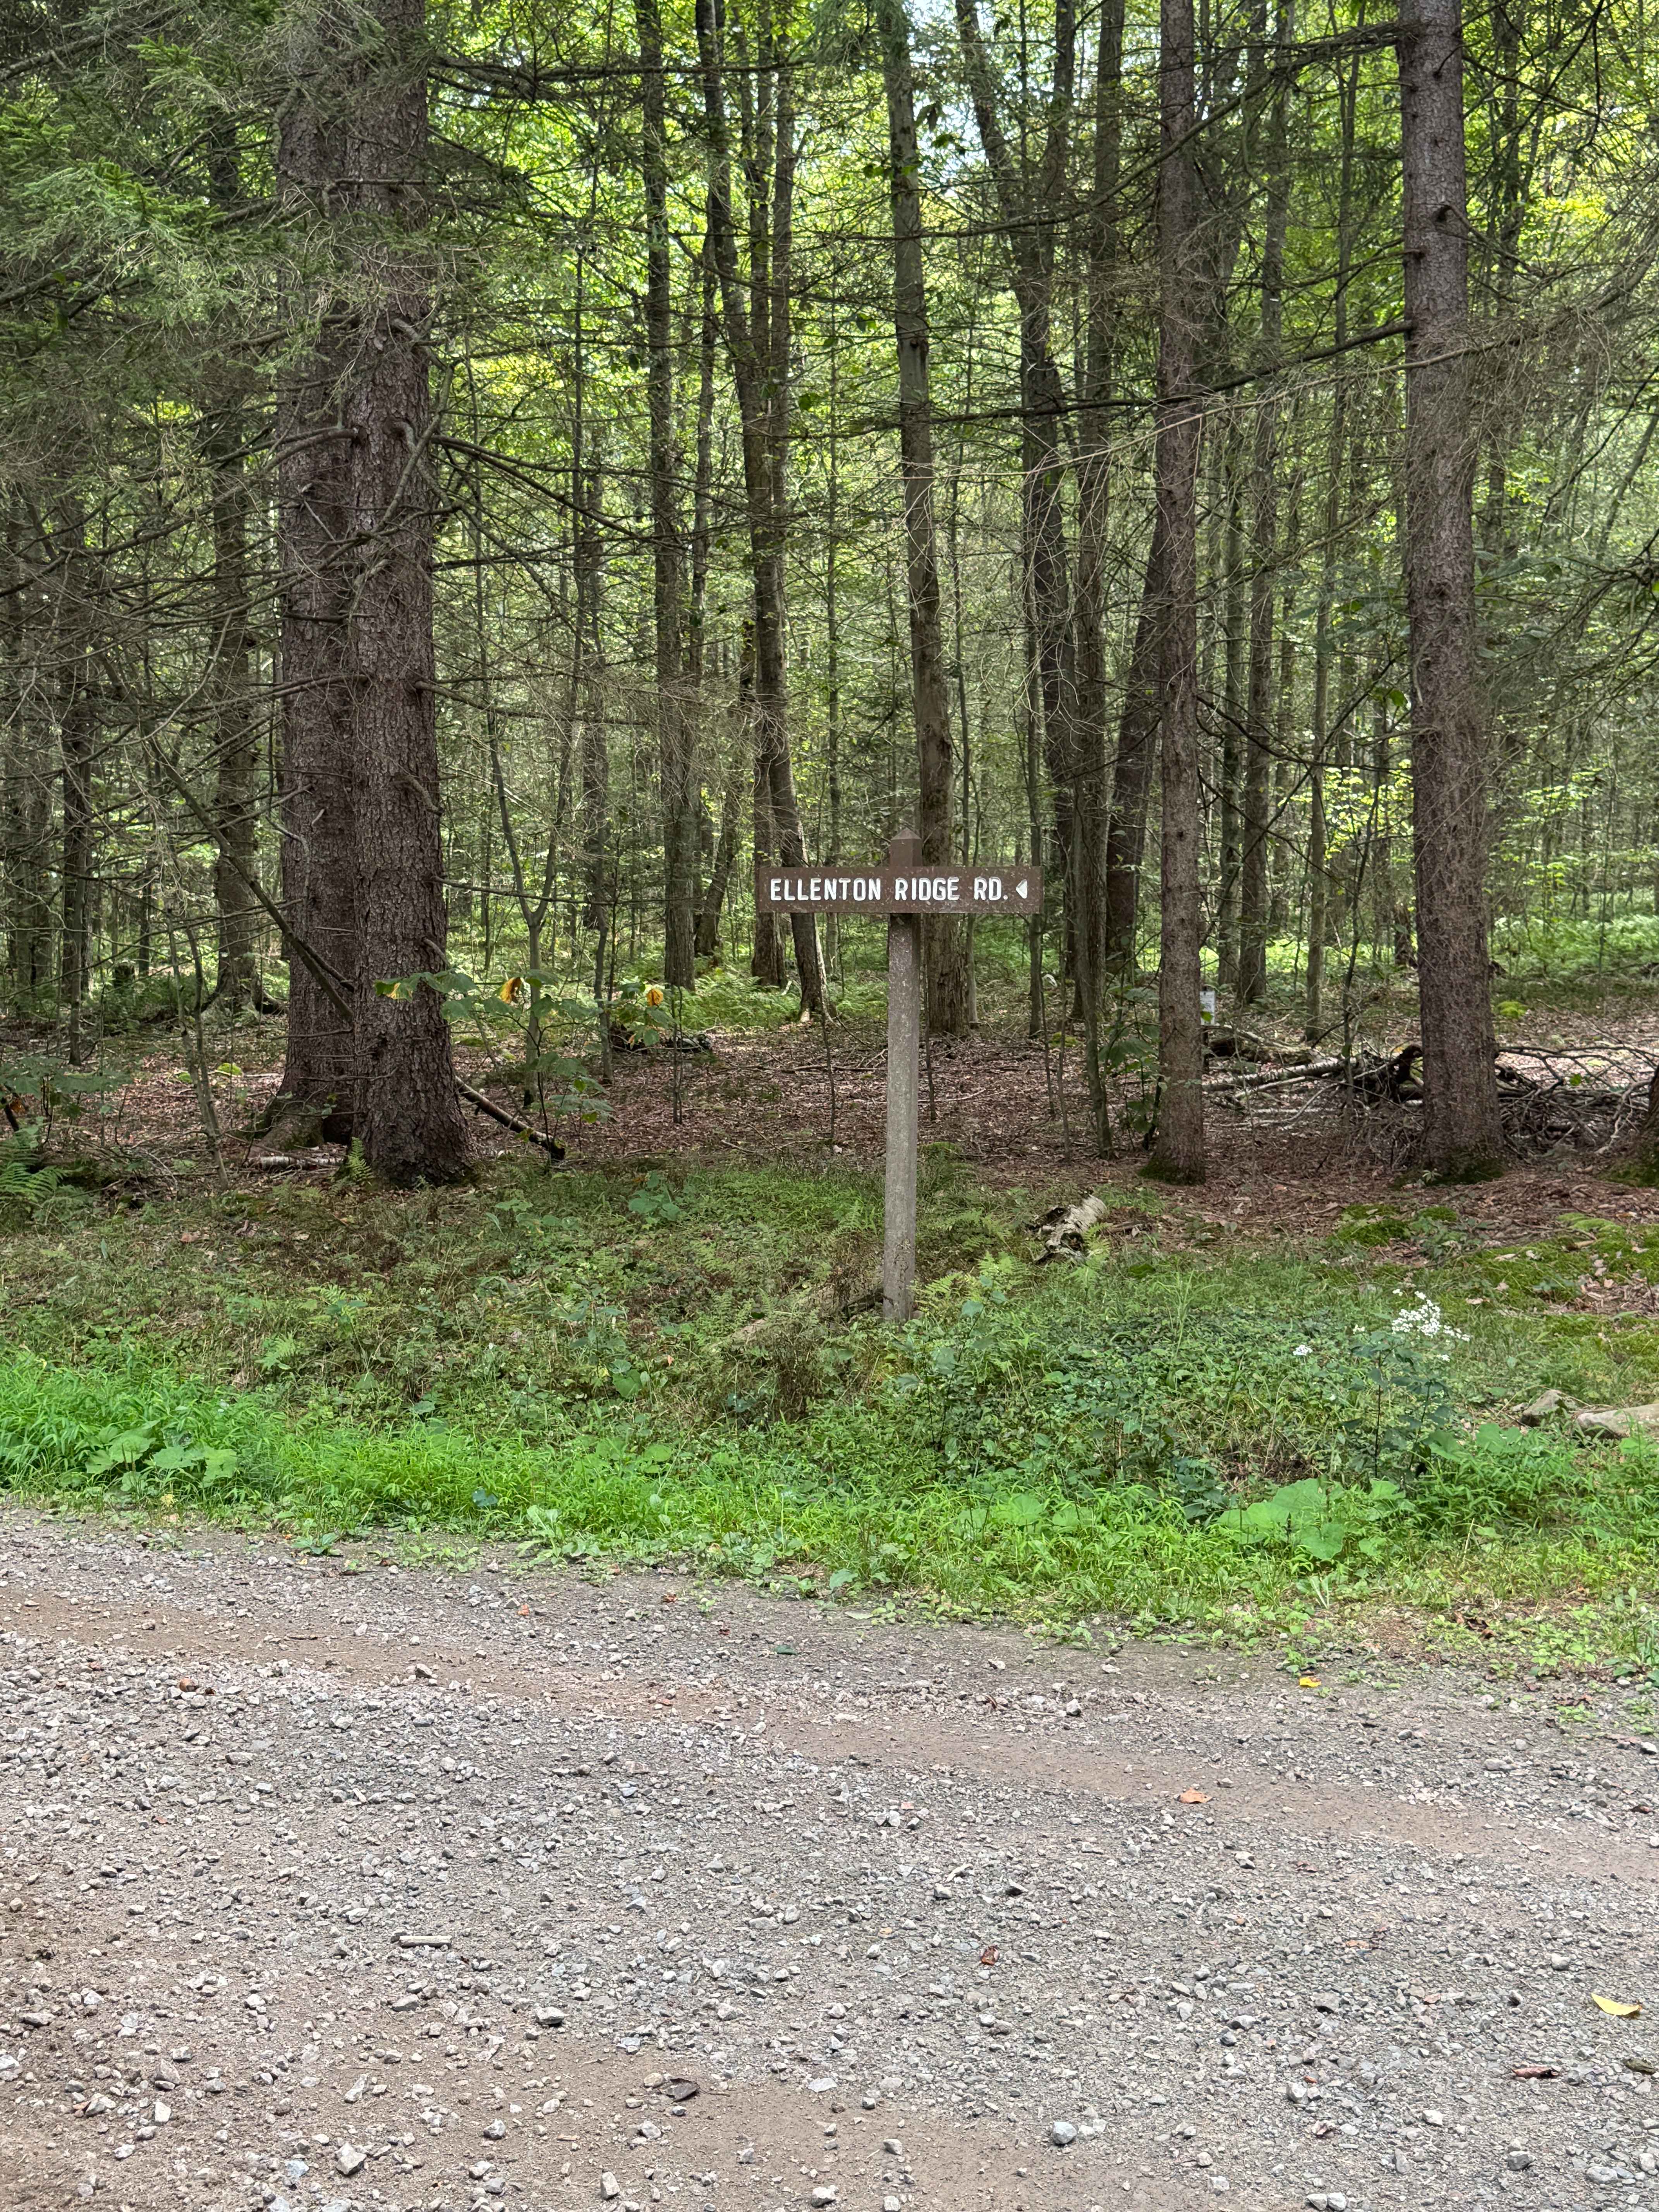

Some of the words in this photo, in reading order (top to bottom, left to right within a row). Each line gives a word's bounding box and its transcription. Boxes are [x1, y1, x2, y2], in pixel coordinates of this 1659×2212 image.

[770, 878, 881, 901] ELLENTON
[895, 877, 960, 901] RIDGE
[974, 876, 1008, 901] RD.
